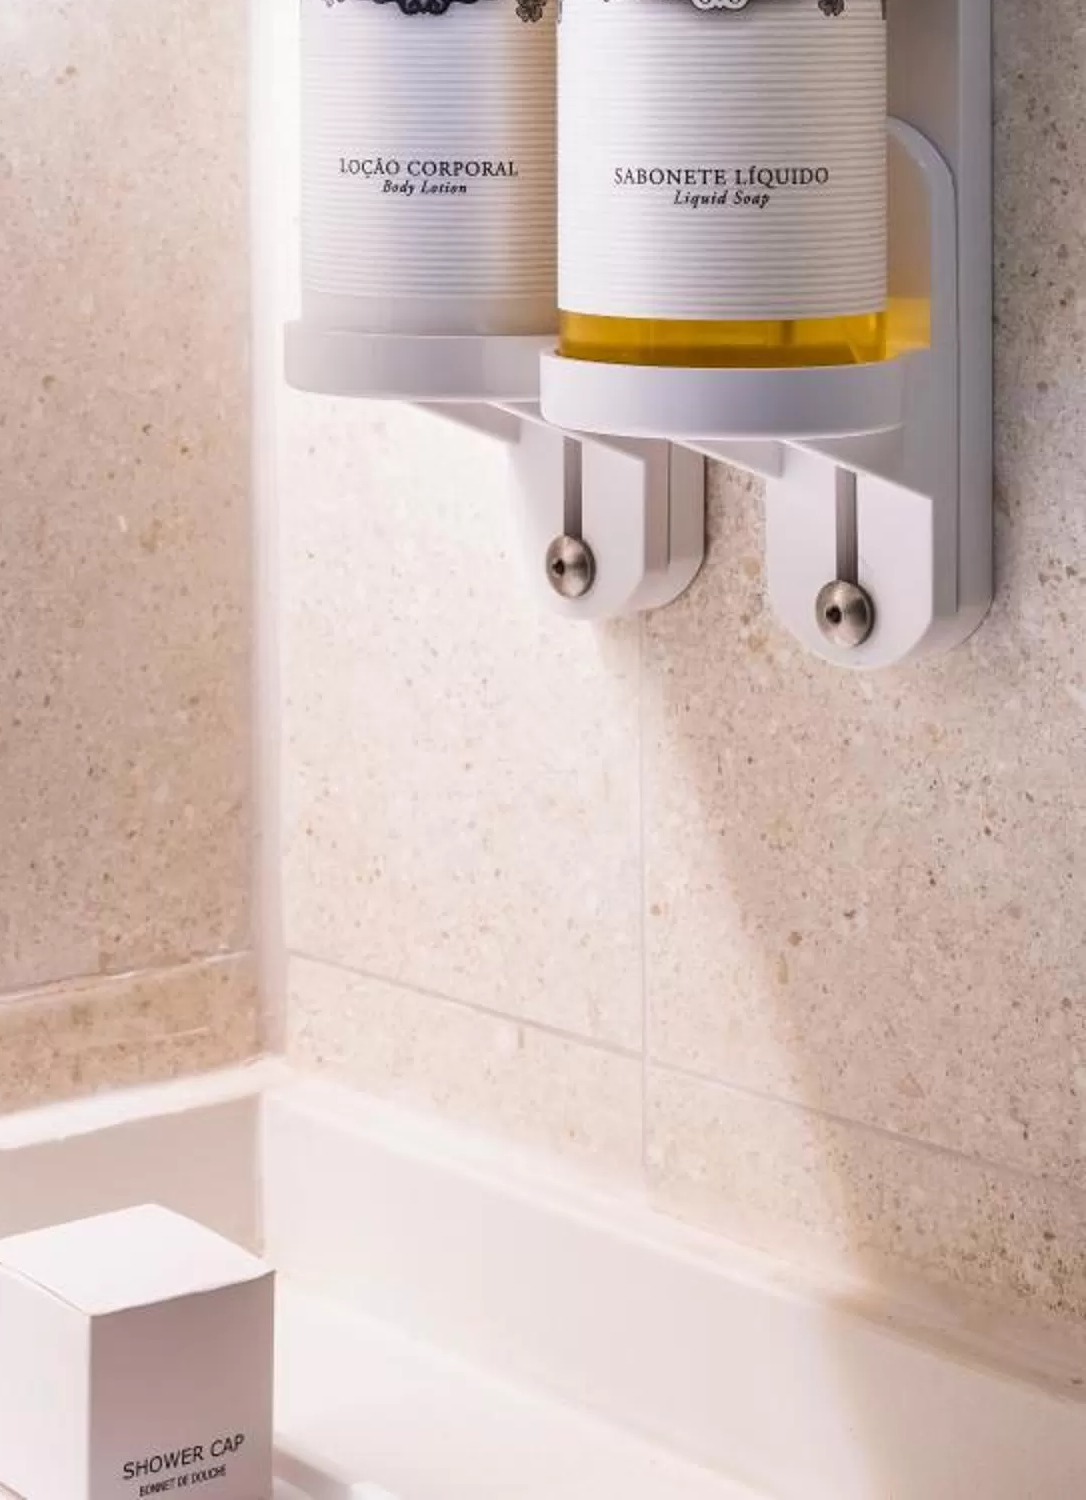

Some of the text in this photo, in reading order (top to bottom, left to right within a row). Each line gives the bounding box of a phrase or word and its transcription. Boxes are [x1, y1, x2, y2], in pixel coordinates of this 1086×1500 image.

[340, 157, 519, 179] LOÇÃO CORPORAL
[614, 165, 830, 189] SABONETE LÍQUIDO
[382, 179, 468, 196] Body Lotion
[673, 190, 771, 208] Liquid Soap
[122, 1434, 245, 1480] SHOWER CAP
[139, 1464, 227, 1497] BONNET DE DOUCHE
